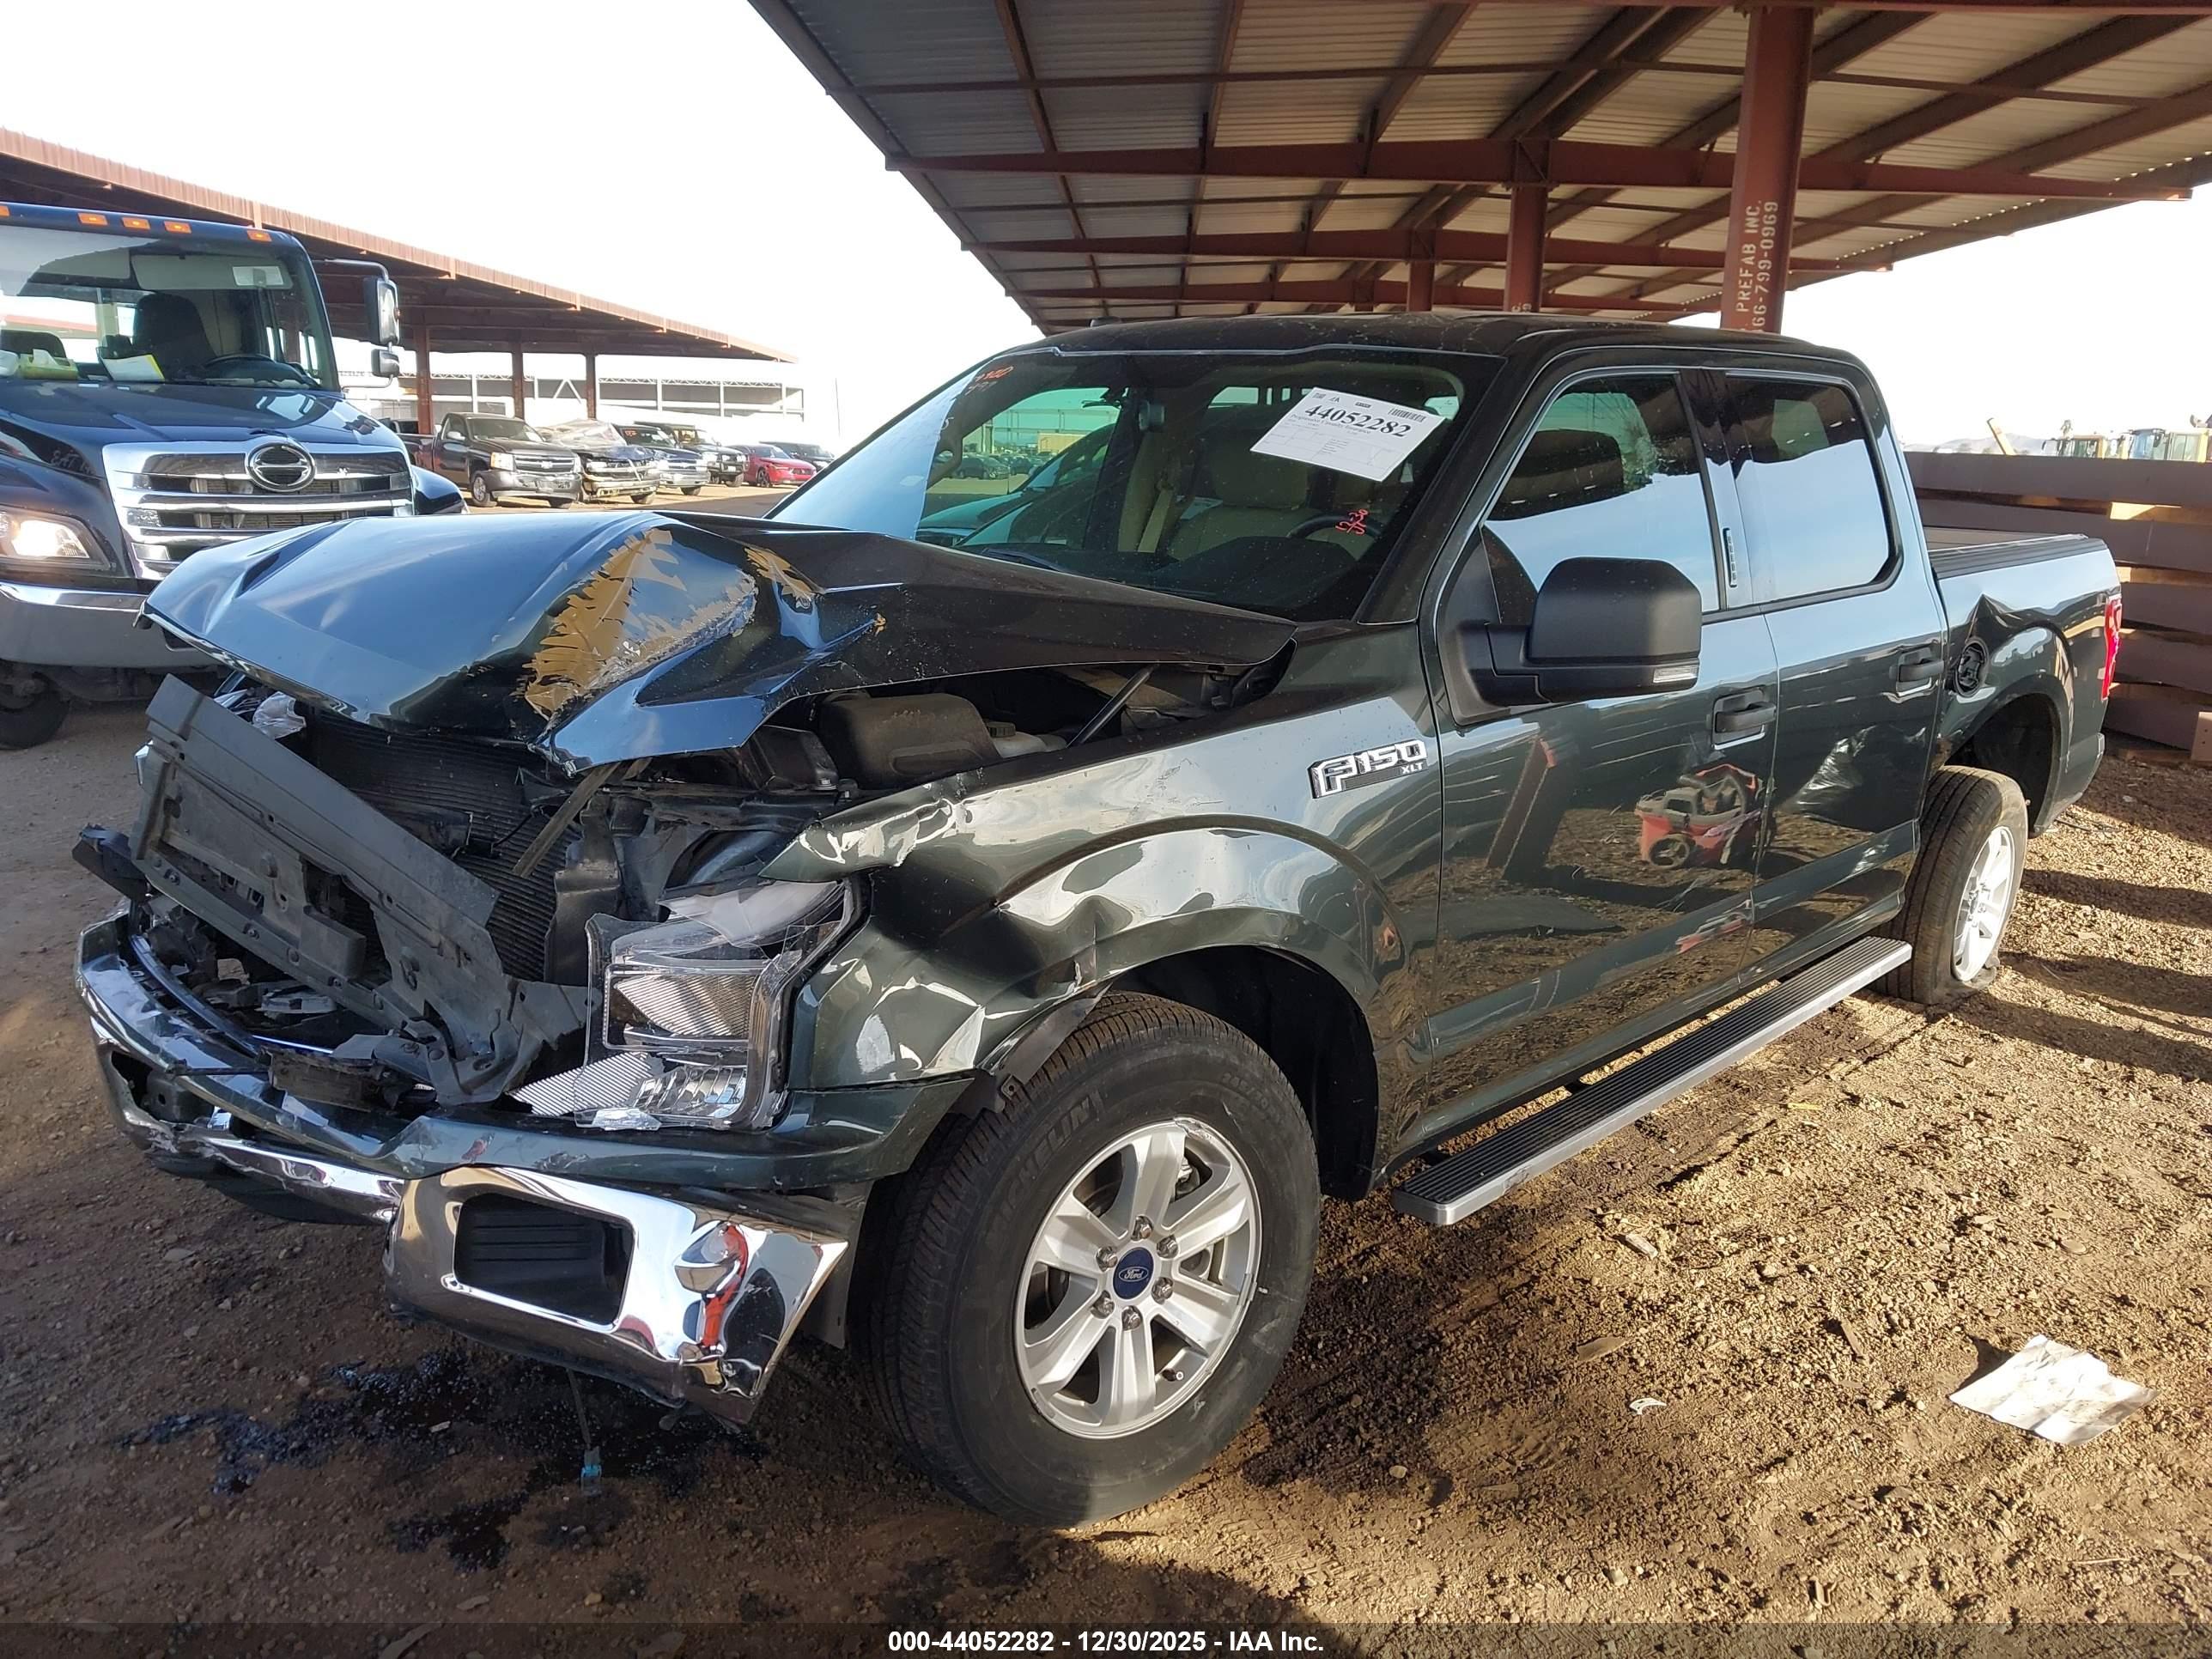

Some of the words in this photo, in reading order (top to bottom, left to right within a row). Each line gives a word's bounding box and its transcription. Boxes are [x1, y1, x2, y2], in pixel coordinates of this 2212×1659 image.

[1744, 200, 1762, 234] INC.
[1735, 243, 1757, 312] PREFAB
[1752, 202, 1779, 332] 66-799-0969
[1304, 404, 1412, 437] 44052282
[1400, 761, 1425, 775] XLT
[1122, 1268, 1146, 1280] Ford
